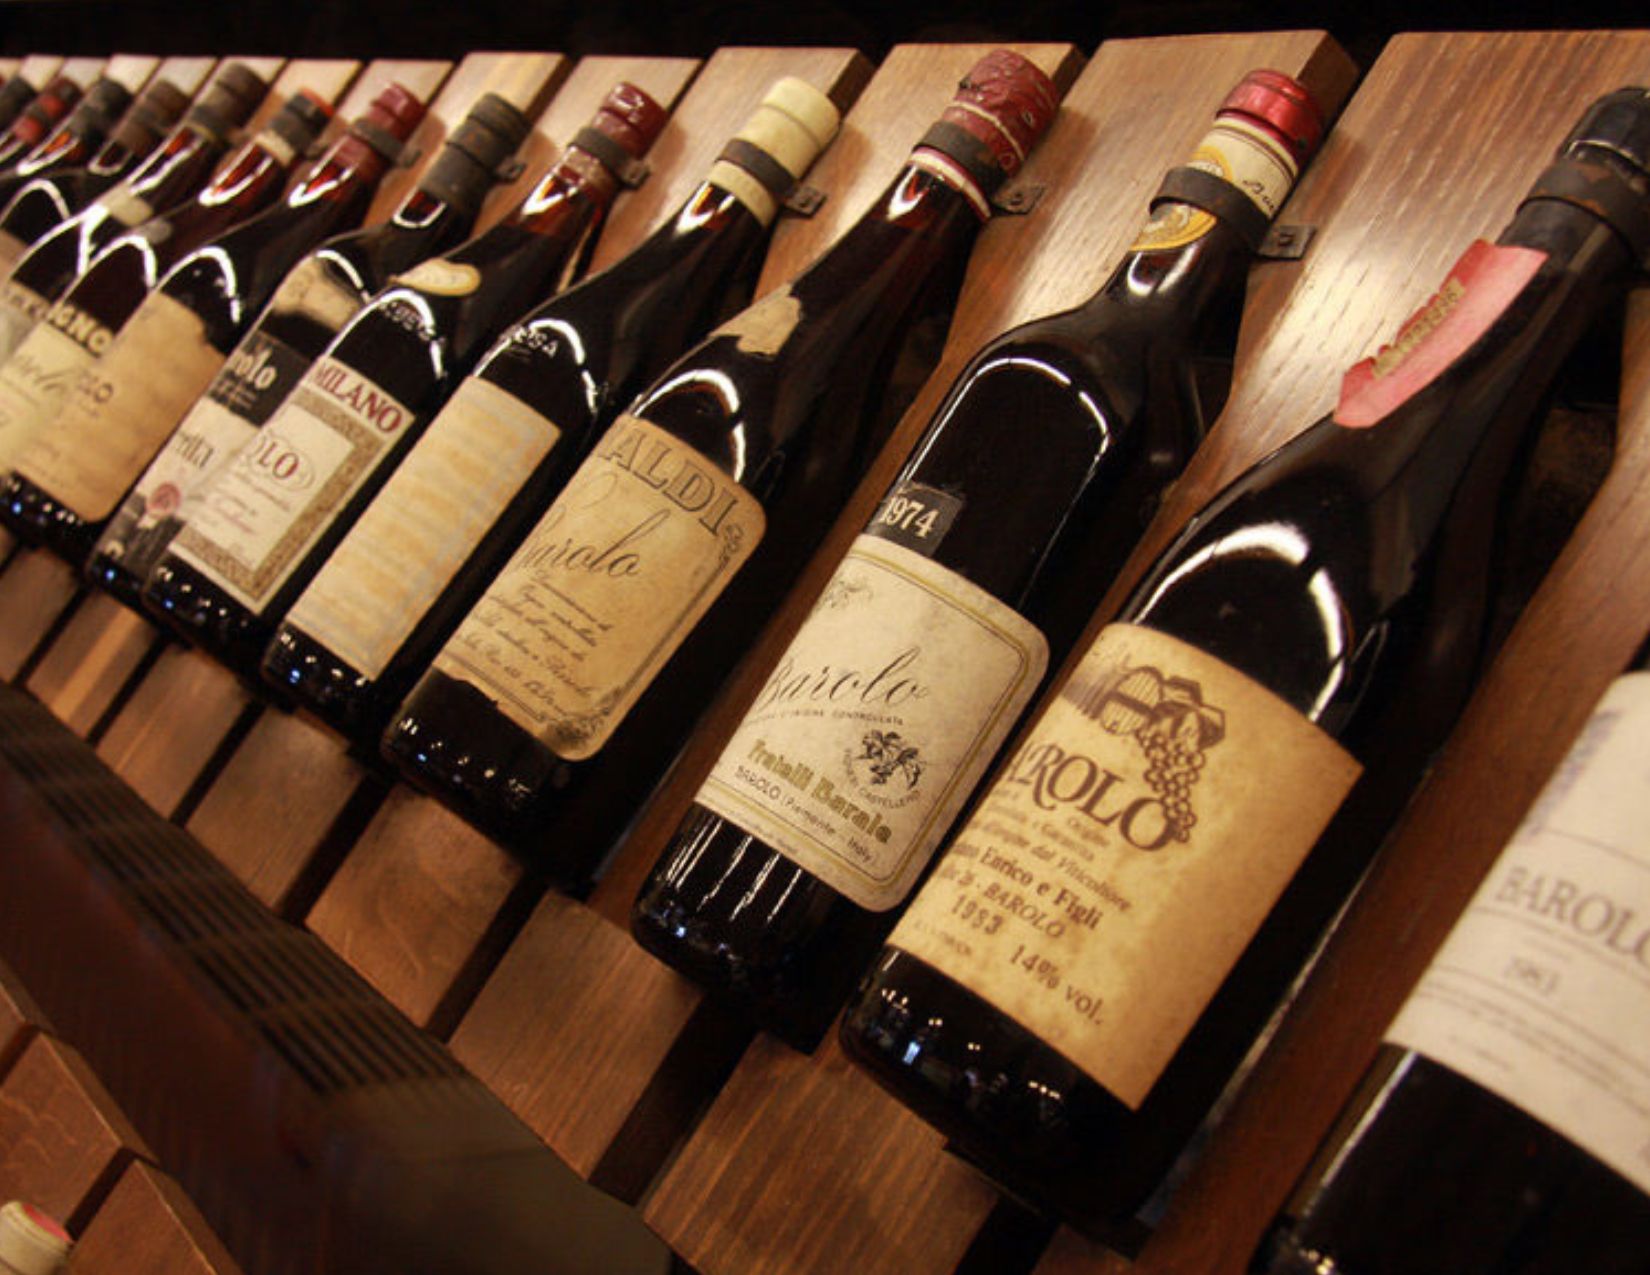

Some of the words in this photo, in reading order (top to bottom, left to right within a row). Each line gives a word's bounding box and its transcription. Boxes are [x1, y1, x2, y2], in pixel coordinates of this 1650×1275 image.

[600, 424, 738, 536] ALDI
[878, 496, 940, 538] 1974
[811, 777, 892, 844] Barale
[980, 846, 1034, 887] Enrico
[1036, 881, 1050, 896] e
[1054, 887, 1104, 930] Figli
[983, 881, 1066, 939] BAROLO
[1009, 943, 1061, 990] 14%
